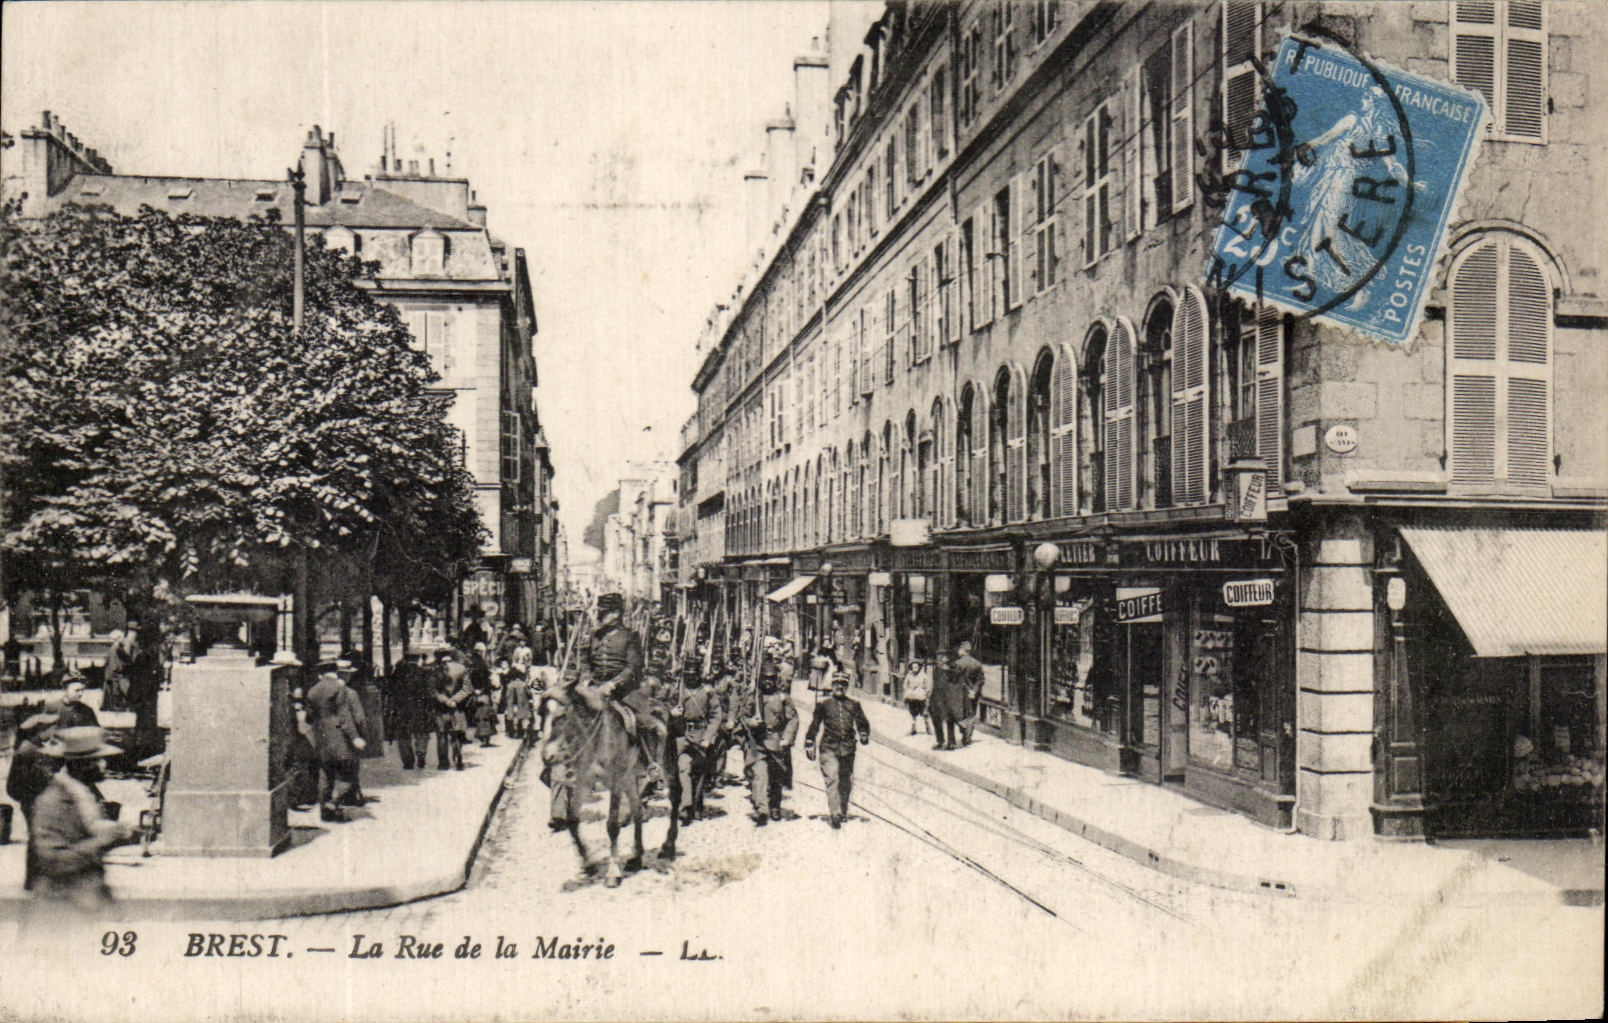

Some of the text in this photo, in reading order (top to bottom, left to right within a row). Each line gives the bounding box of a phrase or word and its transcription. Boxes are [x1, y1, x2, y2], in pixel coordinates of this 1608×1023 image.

[1395, 84, 1473, 124] FRANÇAISE
[1384, 243, 1426, 324] POSTES
[1240, 473, 1265, 518] COIFFEUR
[1146, 539, 1221, 562] COIFFEUR
[1118, 594, 1163, 620] COIFFE
[1226, 582, 1273, 604] COIFFEUR
